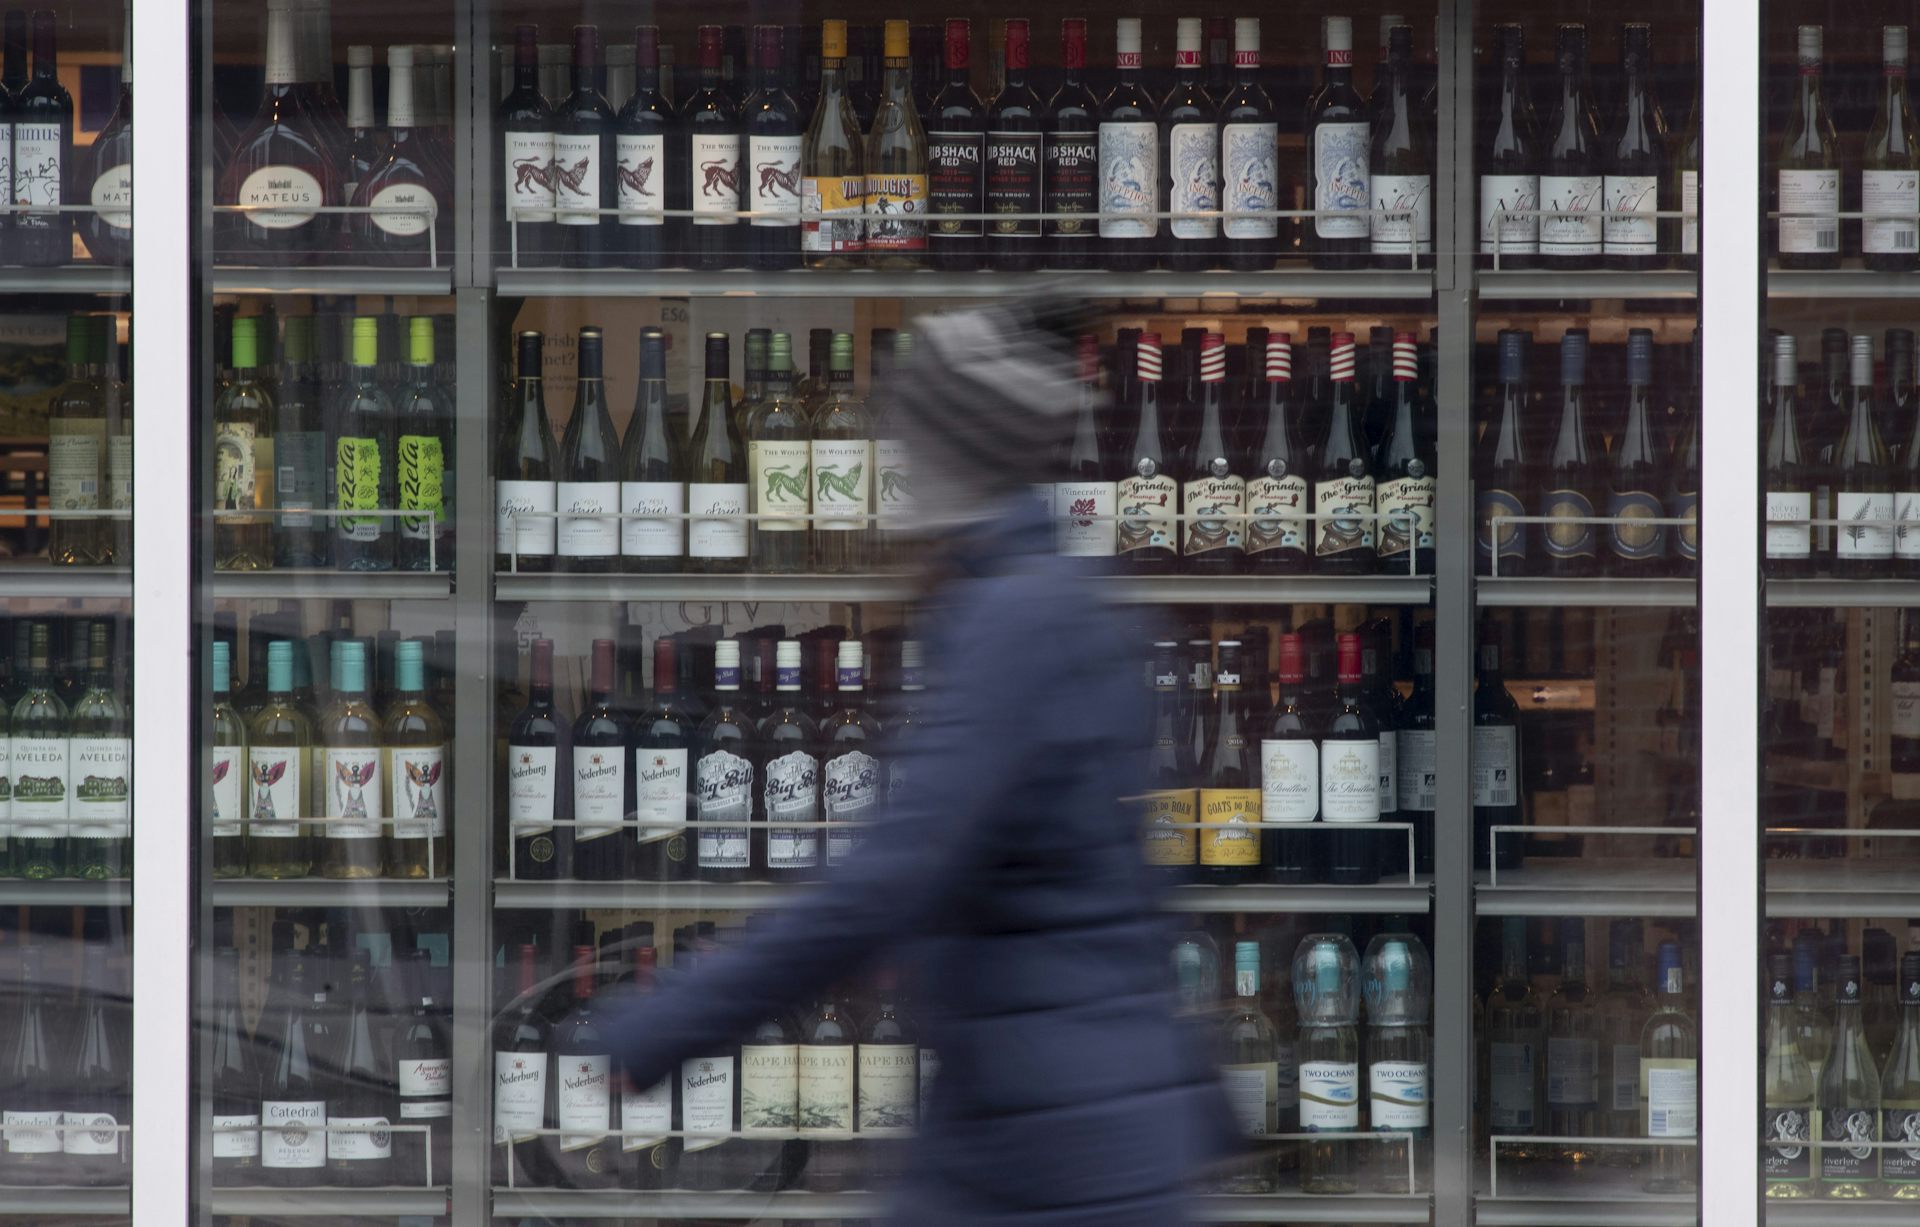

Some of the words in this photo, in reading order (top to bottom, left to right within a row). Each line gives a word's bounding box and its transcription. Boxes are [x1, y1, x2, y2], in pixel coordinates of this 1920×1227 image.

[940, 157, 959, 166] RED
[998, 157, 1016, 166] RED
[1058, 157, 1078, 166] RED
[250, 193, 310, 203] MATEUS
[1064, 488, 1106, 497] Vinecrafter
[1132, 481, 1174, 494] Grinder
[1264, 482, 1305, 495] Grinder
[1188, 490, 1203, 503] The
[1320, 488, 1338, 504] The
[1380, 489, 1395, 504] The
[15, 753, 63, 762] AVELEDA
[80, 753, 127, 762] AVELEDA
[511, 764, 547, 780] Nederburg
[578, 764, 617, 781] Nederburg
[641, 766, 681, 783] Nederburg
[698, 778, 719, 800] Big
[720, 768, 753, 790] Bill
[765, 778, 800, 802] Big
[825, 777, 857, 800] Big
[1324, 782, 1337, 793] The
[1160, 802, 1169, 810] DO
[1171, 801, 1193, 815] ROAM
[1207, 800, 1231, 815] GOATS
[1234, 802, 1242, 810] DO
[744, 1055, 780, 1067] CAPE
[821, 1056, 849, 1067] BAY
[859, 1055, 891, 1066] CAPE
[499, 1070, 540, 1087] Nederburg
[1304, 1069, 1321, 1077] TWO
[1322, 1069, 1355, 1077] OCEANS
[564, 1072, 605, 1090] Nederburg
[686, 1071, 727, 1089] Nederburg
[270, 1106, 319, 1119] Catedral
